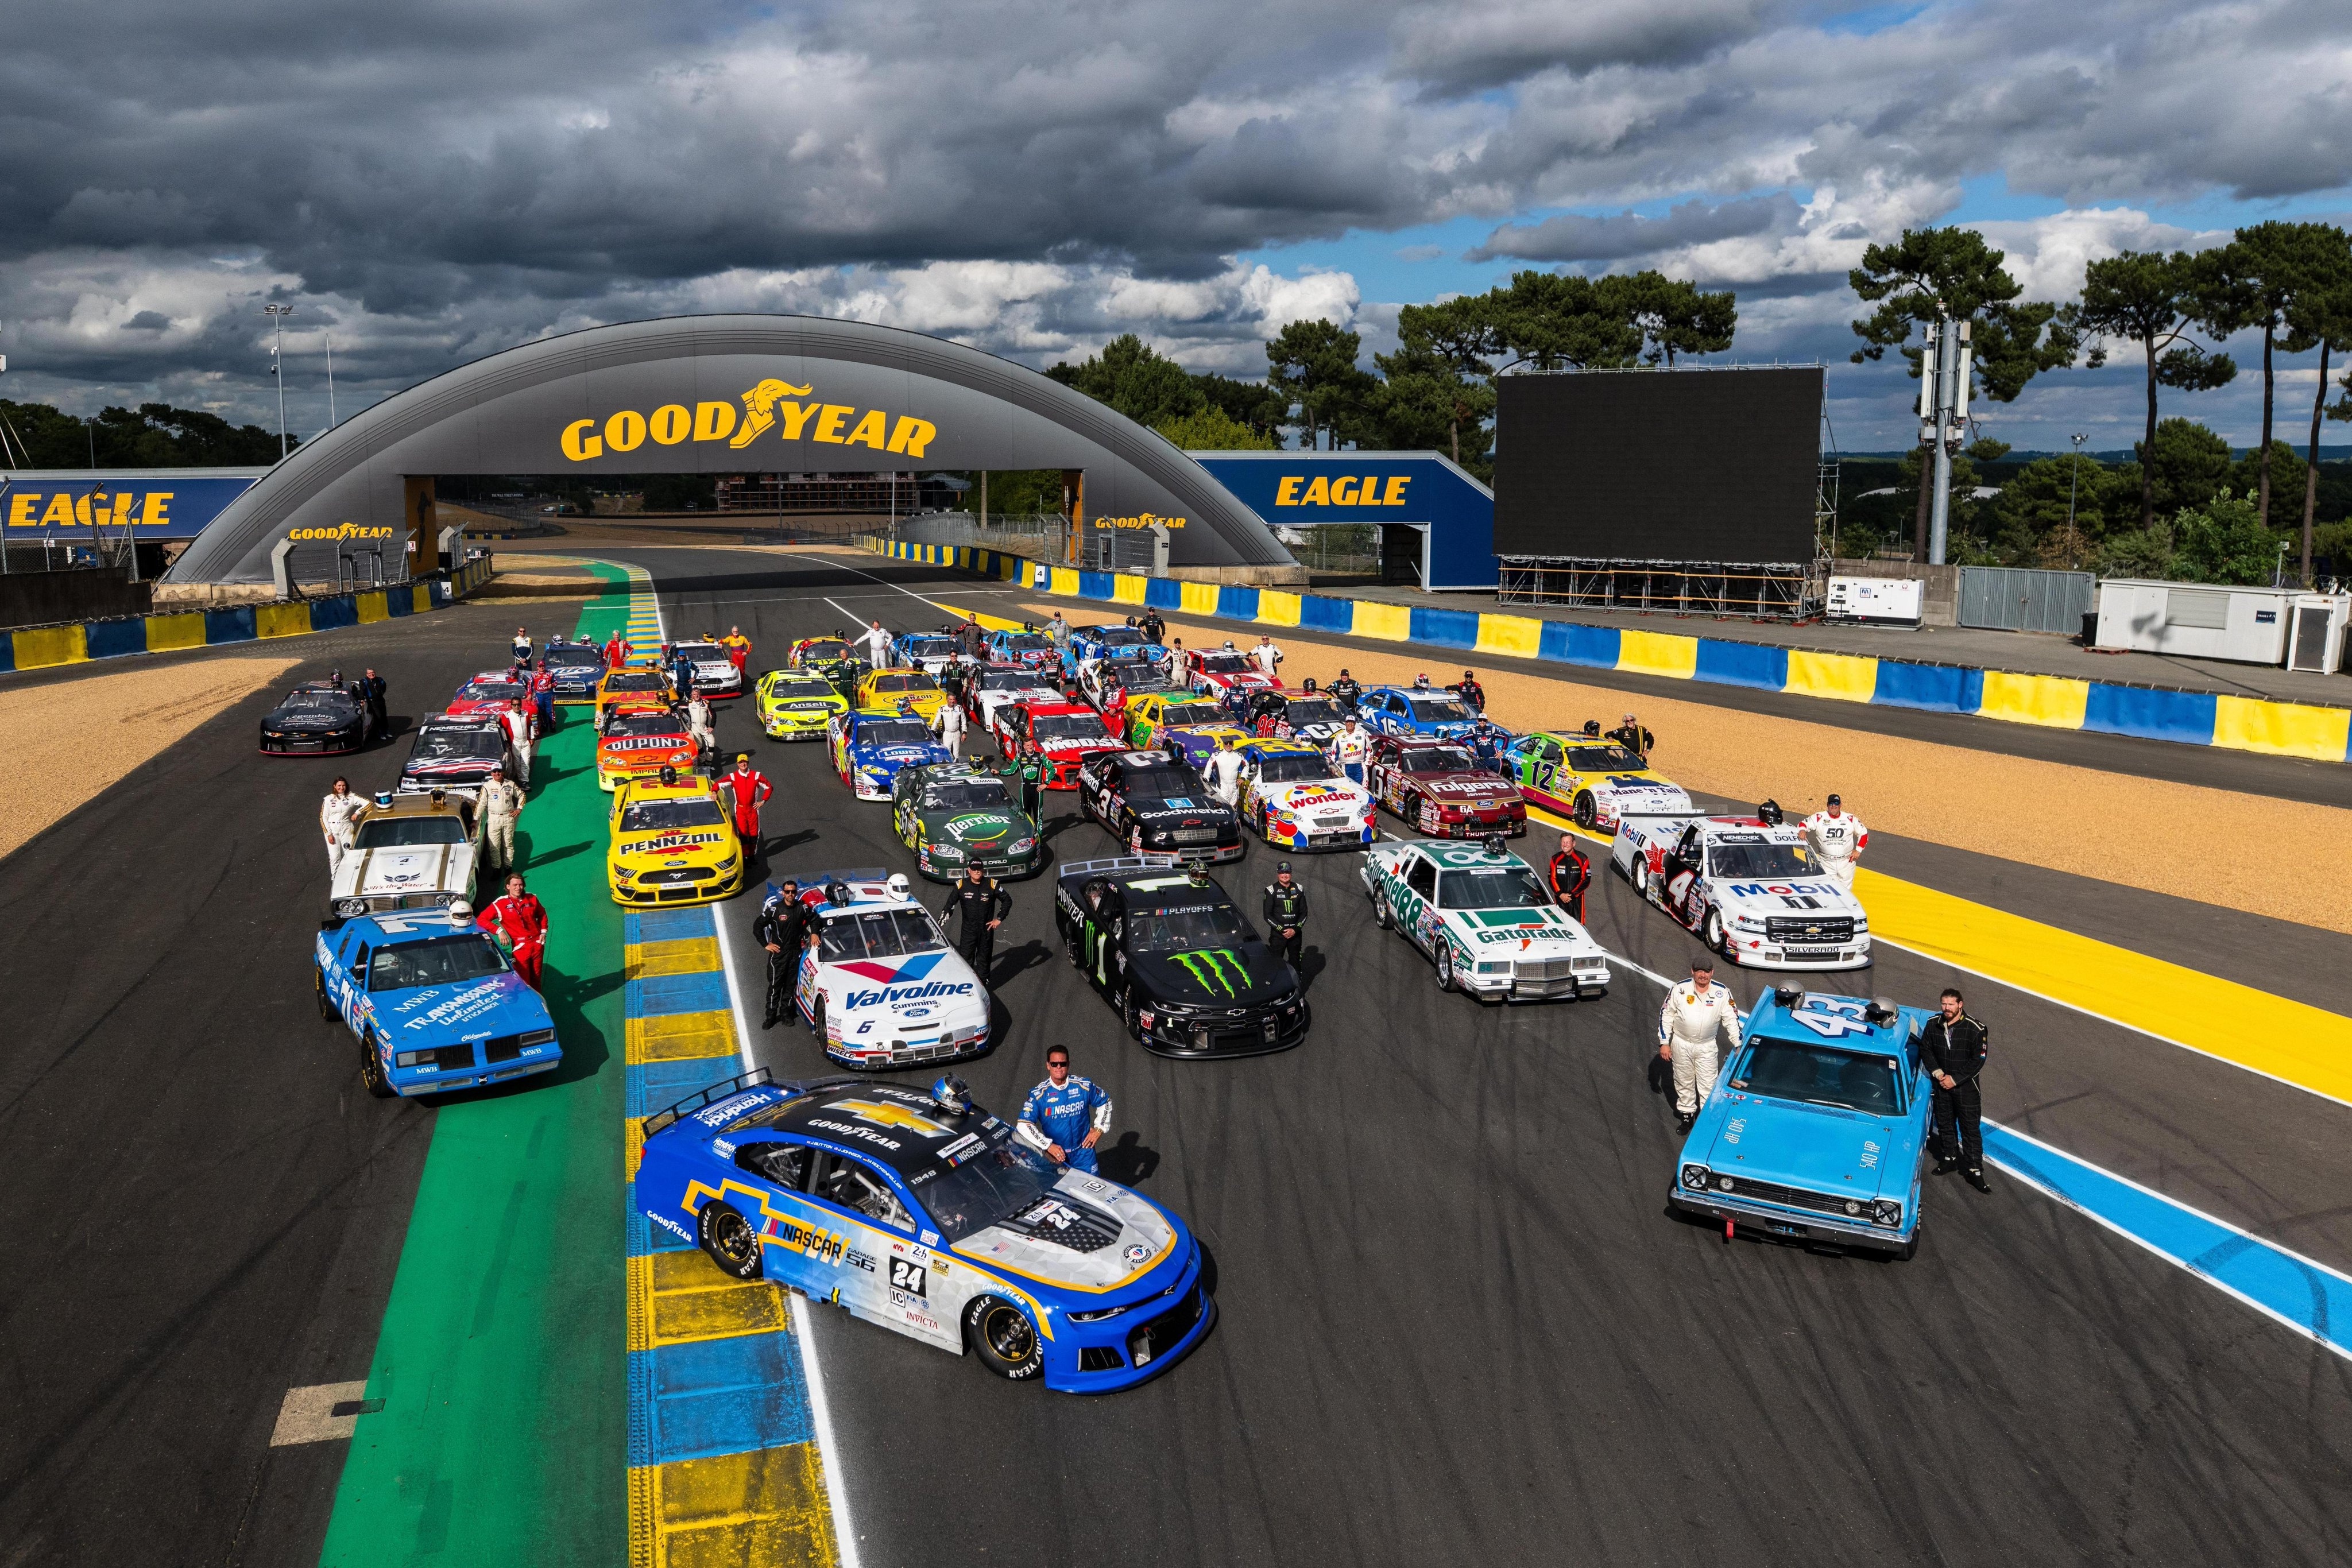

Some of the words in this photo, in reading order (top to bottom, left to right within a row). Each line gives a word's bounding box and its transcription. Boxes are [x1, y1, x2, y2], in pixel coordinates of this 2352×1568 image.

[1275, 477, 1411, 506] EAGLE
[9, 492, 174, 526] EAGLE
[1256, 714, 1276, 738] 96
[1380, 716, 1398, 735] 15
[1132, 722, 1152, 746] 23
[1040, 737, 1126, 752] MOOSE
[1344, 749, 1362, 758] wonder
[1505, 749, 1523, 765] Arrow
[1531, 760, 1556, 793] 12
[1428, 781, 1510, 793] Folgers
[1608, 788, 1643, 796] Mane
[1097, 788, 1111, 819] 3
[1287, 792, 1357, 810] wonder
[1140, 808, 1230, 819] Goodwrench
[943, 815, 1012, 842] perrier
[1158, 832, 1167, 840] 3
[1620, 822, 1640, 845] Mobil
[620, 832, 726, 856] PENNZOIL
[1668, 869, 1695, 914] 4
[1729, 882, 1842, 897] Mobil
[1169, 905, 1213, 916] PLAYOFFS
[1476, 927, 1578, 944] Gatorade
[1749, 940, 1761, 948] 4
[1479, 963, 1492, 972] 88
[392, 990, 440, 1014] MWB
[845, 981, 974, 1011] Valvoline
[438, 992, 504, 1026] Unlimited
[891, 999, 938, 1011] Cummins
[909, 1008, 927, 1017] Ford
[856, 1020, 876, 1034] 6
[1141, 1019, 1151, 1029] 3M
[1167, 1017, 1173, 1028] 1
[461, 1031, 493, 1042] Oldsmobile
[828, 1039, 843, 1048] MOOG
[522, 1048, 542, 1057] MWB
[827, 1046, 856, 1059] WISECO
[1054, 1100, 1085, 1115] NASCAR
[991, 1126, 1009, 1140] 2023
[713, 1137, 736, 1152] Hendrick
[956, 1140, 988, 1163] NASCAR
[910, 1169, 937, 1186] 1948
[1086, 1183, 1102, 1191] IC
[702, 1208, 712, 1240] EAGLE
[1046, 1206, 1081, 1230] 24
[783, 1224, 842, 1260] NASCAR
[848, 1248, 877, 1262] GARAGE
[933, 1263, 948, 1273] CLASSIC
[892, 1261, 923, 1292] 24
[891, 1291, 904, 1304] IC
[906, 1295, 916, 1304] FIA
[970, 1296, 991, 1326] EAGLE
[906, 1311, 939, 1330] INVICTA
